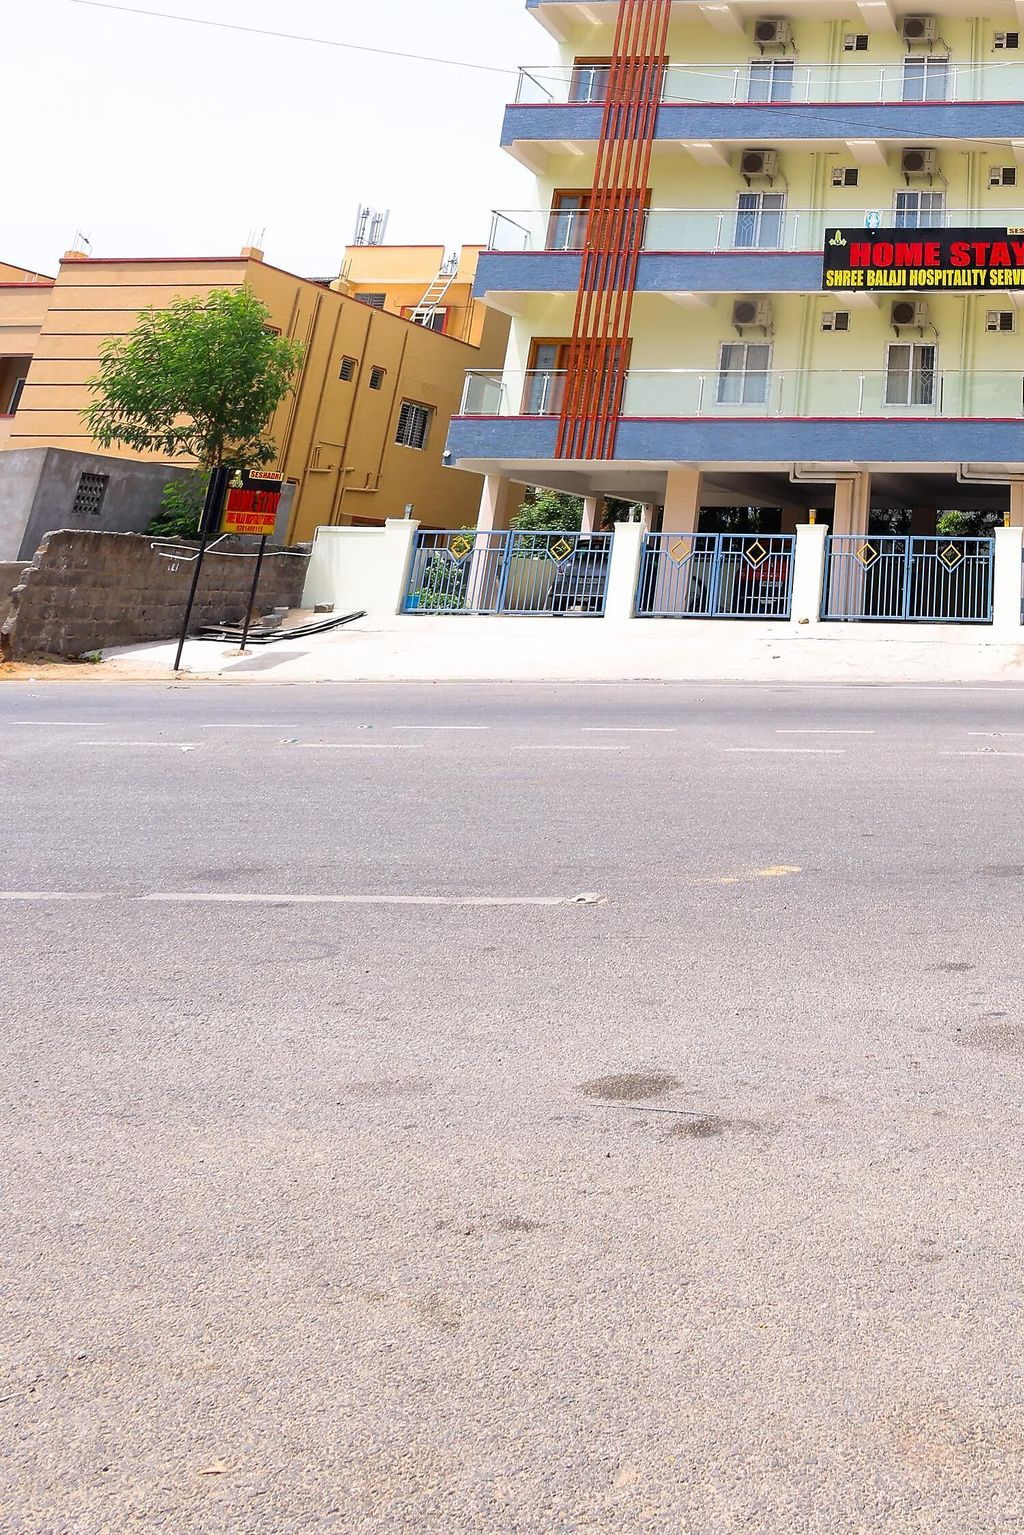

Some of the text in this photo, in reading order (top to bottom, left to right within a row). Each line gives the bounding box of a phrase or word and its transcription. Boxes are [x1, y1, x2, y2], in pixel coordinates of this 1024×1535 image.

[849, 241, 940, 267] HOME
[826, 269, 864, 286] SHREE
[867, 269, 906, 286] BALAJI
[909, 269, 986, 286] HOSPITALITY
[250, 470, 282, 480] SESHADRI
